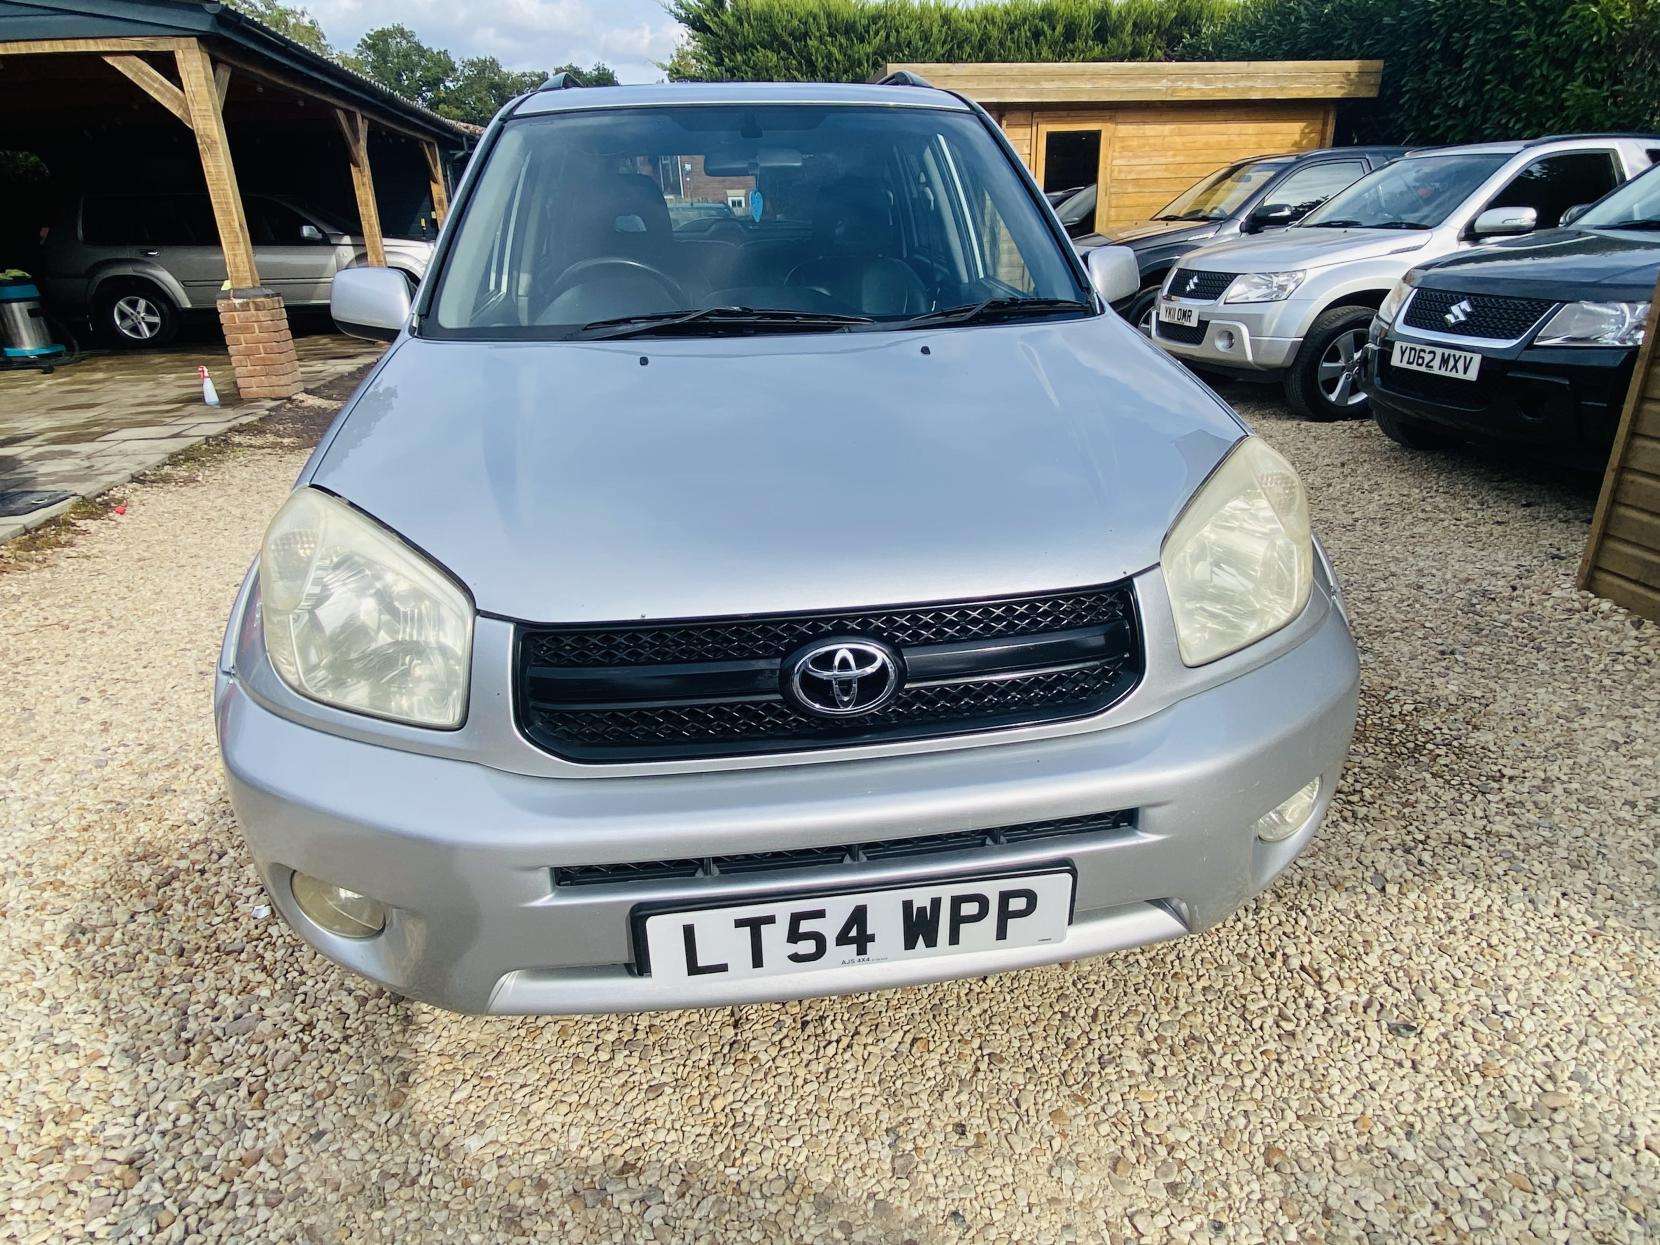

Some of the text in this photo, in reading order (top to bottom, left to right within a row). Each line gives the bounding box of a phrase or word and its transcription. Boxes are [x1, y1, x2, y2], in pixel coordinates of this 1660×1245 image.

[1399, 345, 1474, 376] YD62 MXV
[682, 887, 1039, 977] LT54 WPP
